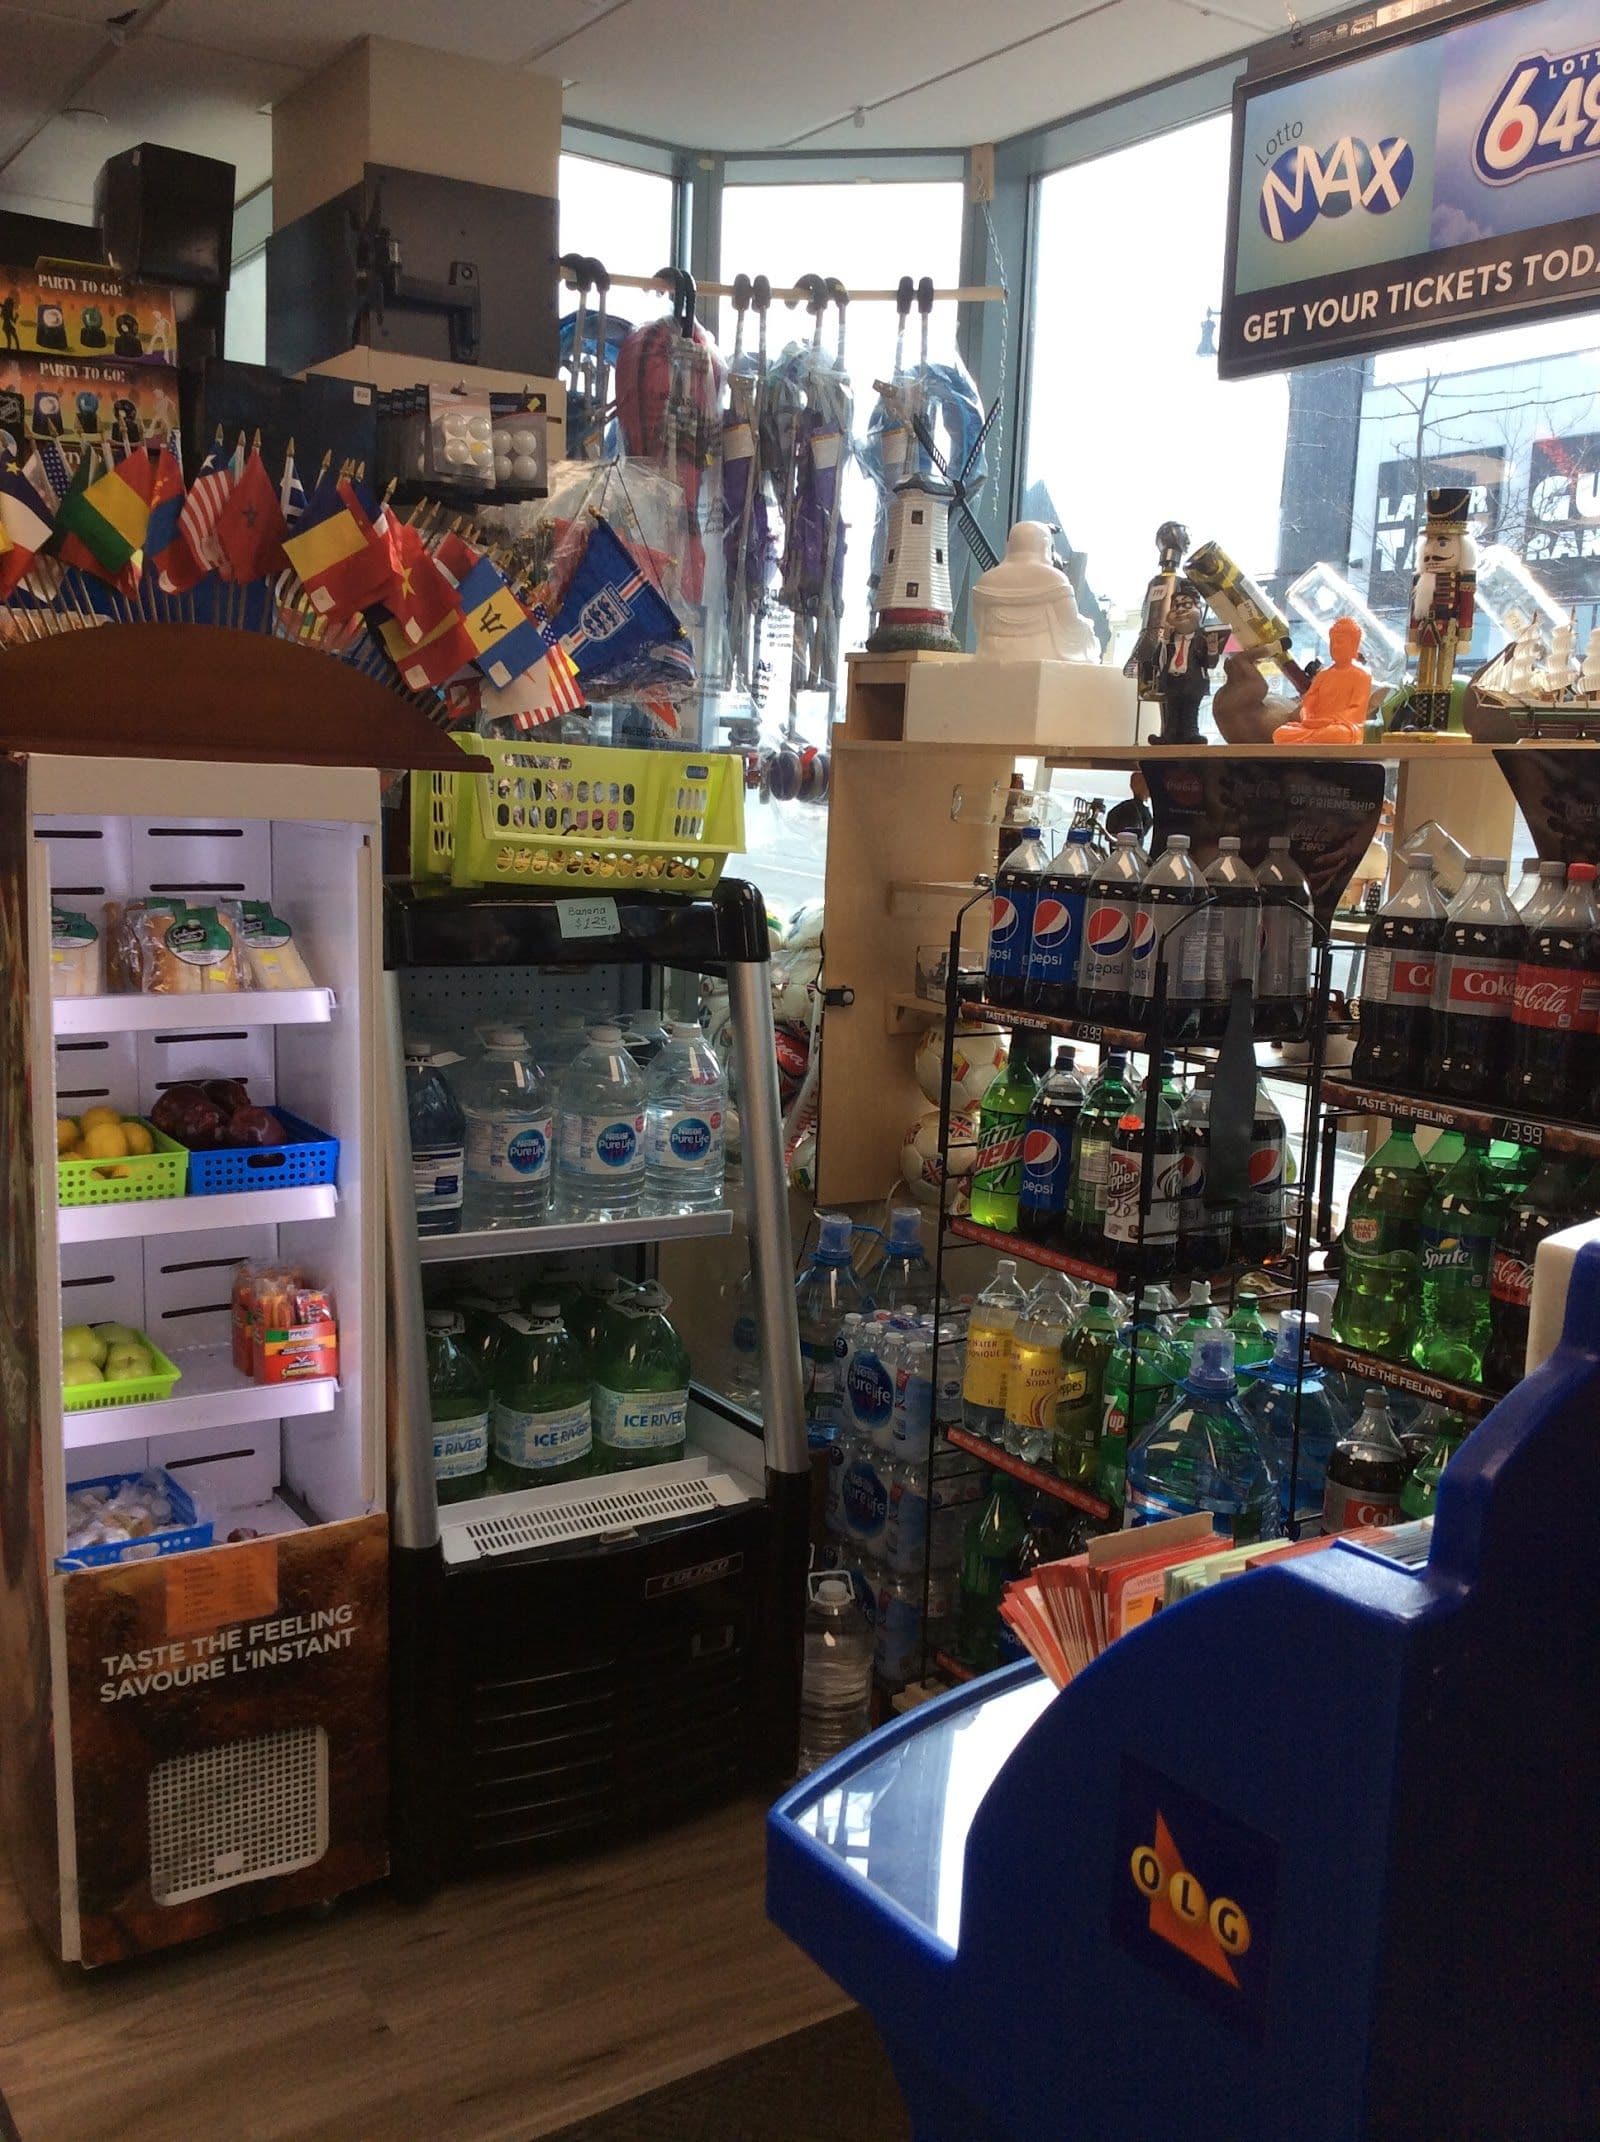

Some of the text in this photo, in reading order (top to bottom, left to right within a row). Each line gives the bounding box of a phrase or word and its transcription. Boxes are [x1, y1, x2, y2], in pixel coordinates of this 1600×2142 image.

[1255, 121, 1304, 168] Lotto
[1261, 136, 1408, 242] MAX
[38, 274, 123, 297] PARTY TO GO!
[1243, 306, 1295, 343] GET
[1303, 293, 1380, 331] YOUR
[1387, 260, 1513, 315] TICKETS
[39, 362, 126, 382] PARTY TO GO!
[989, 948, 1012, 962] epsi
[1030, 952, 1063, 967] pepsi
[1087, 960, 1124, 976] pepsi
[985, 1010, 1047, 1030] TASTE THE FEELING
[1356, 1096, 1454, 1125] TASTE THE FEELING
[672, 1133, 693, 1145] Pure
[1022, 1180, 1054, 1195] pepsi
[1422, 1249, 1469, 1269] Sprite
[1345, 1359, 1443, 1400] TASTE THE FEELING
[624, 1410, 684, 1428] ICE RIVER
[534, 1423, 589, 1448] ICE RIVER
[444, 1437, 483, 1457] RIVER
[101, 1603, 354, 1678] TASTE THE FEELING
[99, 1626, 358, 1704] SAVOURE L'INSTANT
[1139, 1854, 1240, 1946] OLG
